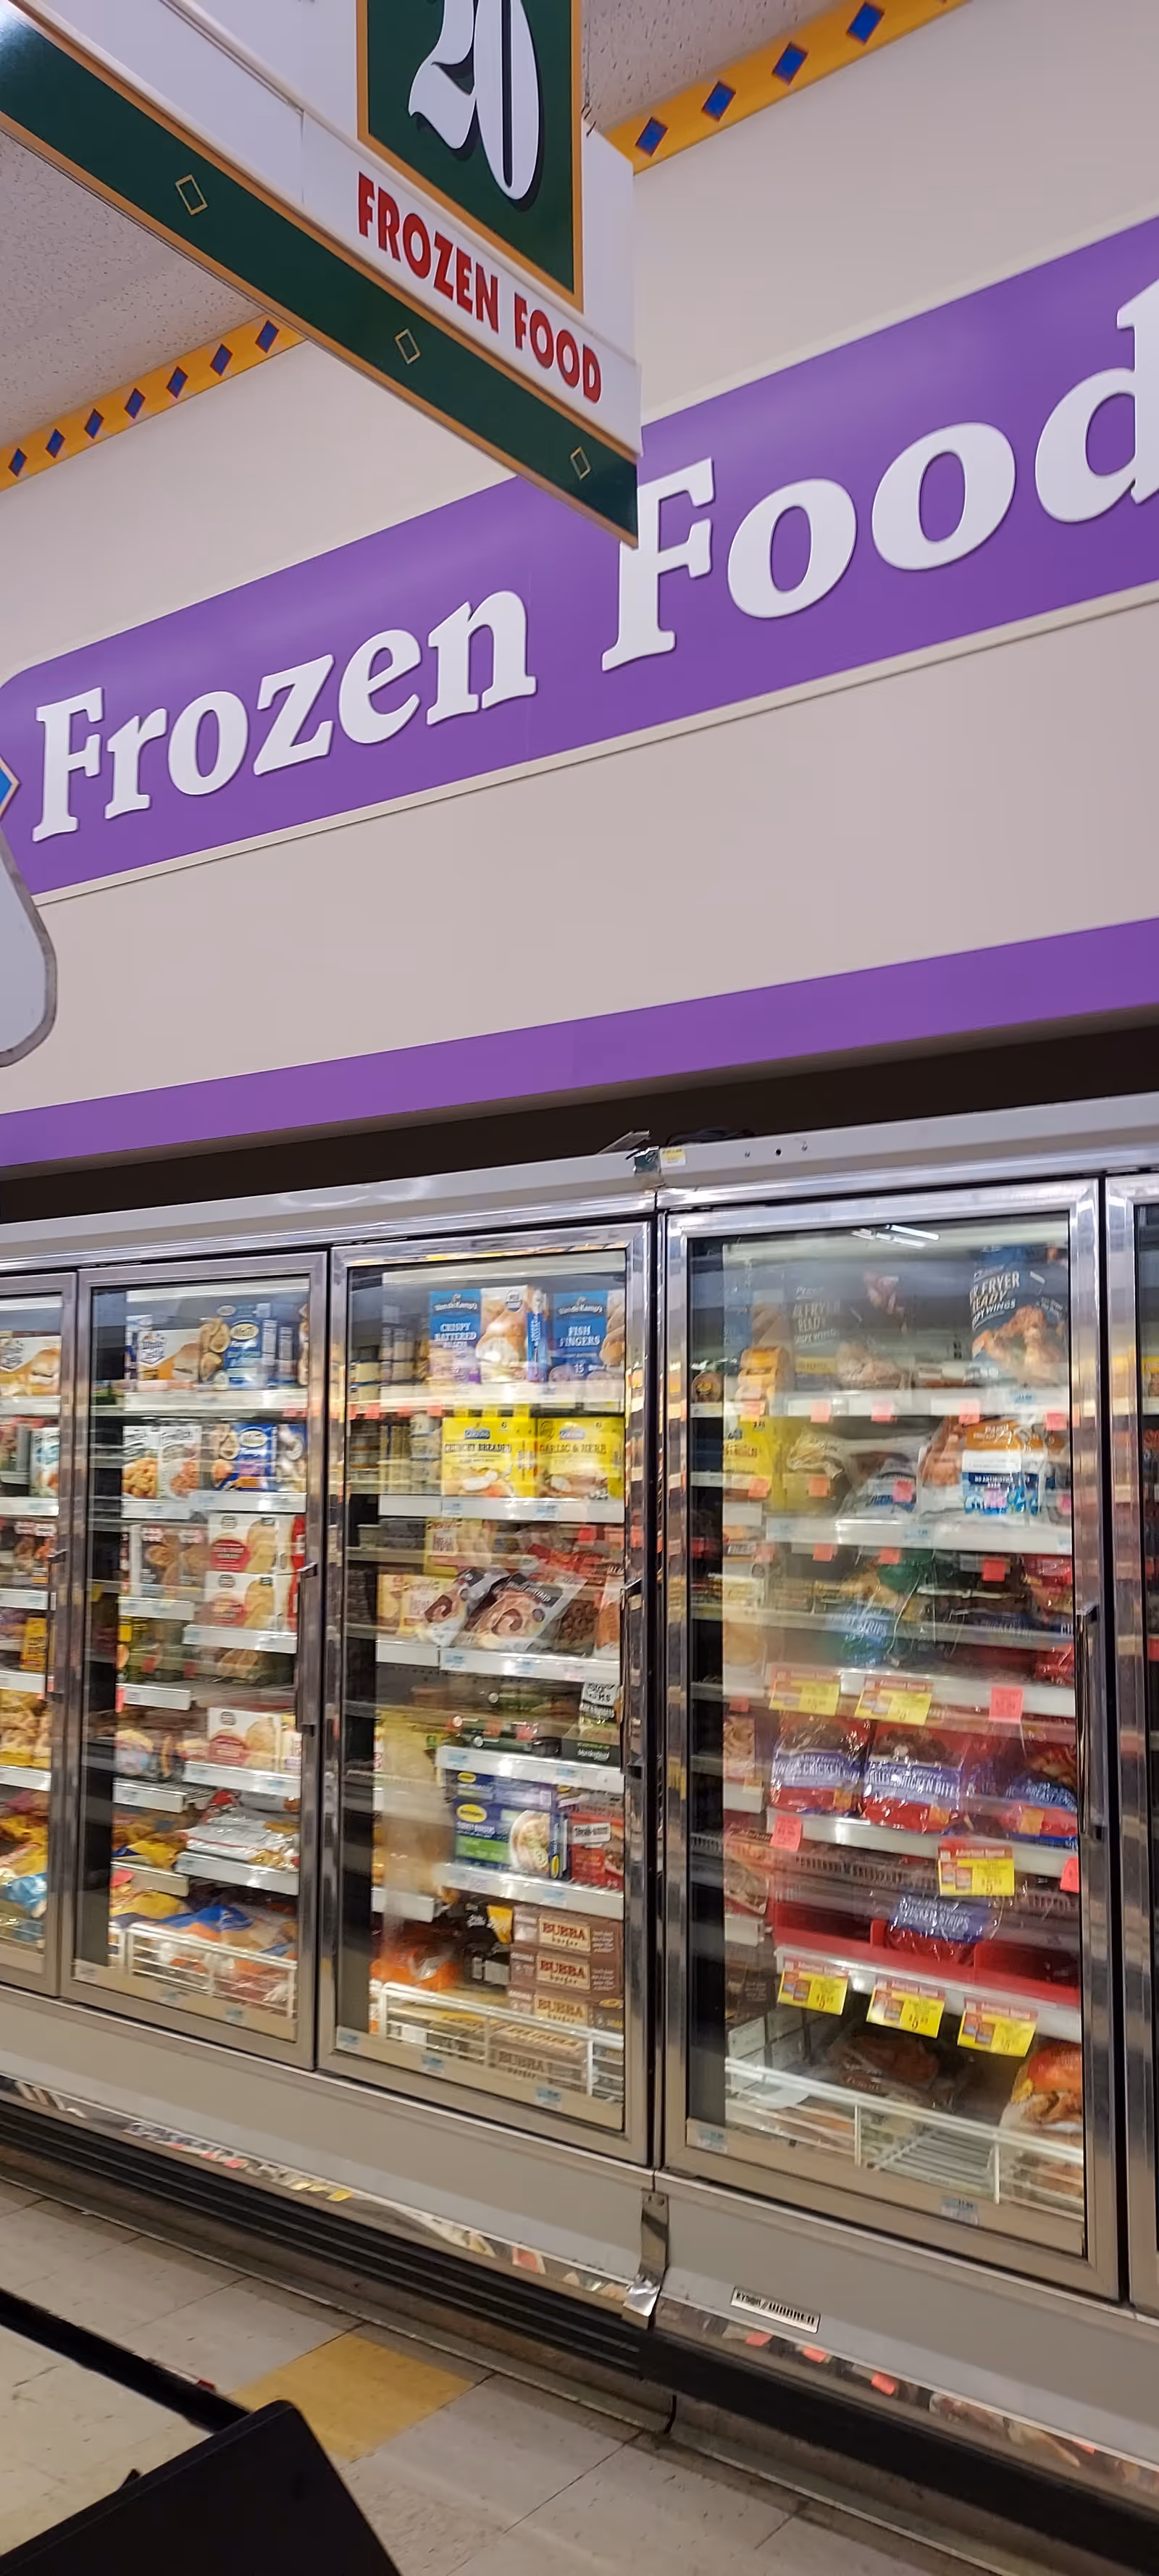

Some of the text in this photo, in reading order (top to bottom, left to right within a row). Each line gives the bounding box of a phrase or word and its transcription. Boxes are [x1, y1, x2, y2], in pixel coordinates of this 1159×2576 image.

[409, 0, 540, 200] 20
[358, 172, 602, 403] FROZEN FOOD
[32, 590, 537, 842] Frozen
[982, 1271, 1020, 1295] FRYER
[434, 1331, 477, 1342] BATTERED
[440, 1323, 471, 1332] CRISPY
[568, 1325, 591, 1337] FISH
[558, 1334, 601, 1347] FINGERS
[543, 1923, 586, 1941] BUBBA
[552, 1936, 579, 1947] burger
[540, 1960, 585, 1979] BUBBA
[550, 1973, 578, 1985] burger
[537, 1999, 583, 2017] BUBBA
[547, 2012, 575, 2023] burger
[499, 2050, 545, 2075] BUBBA
